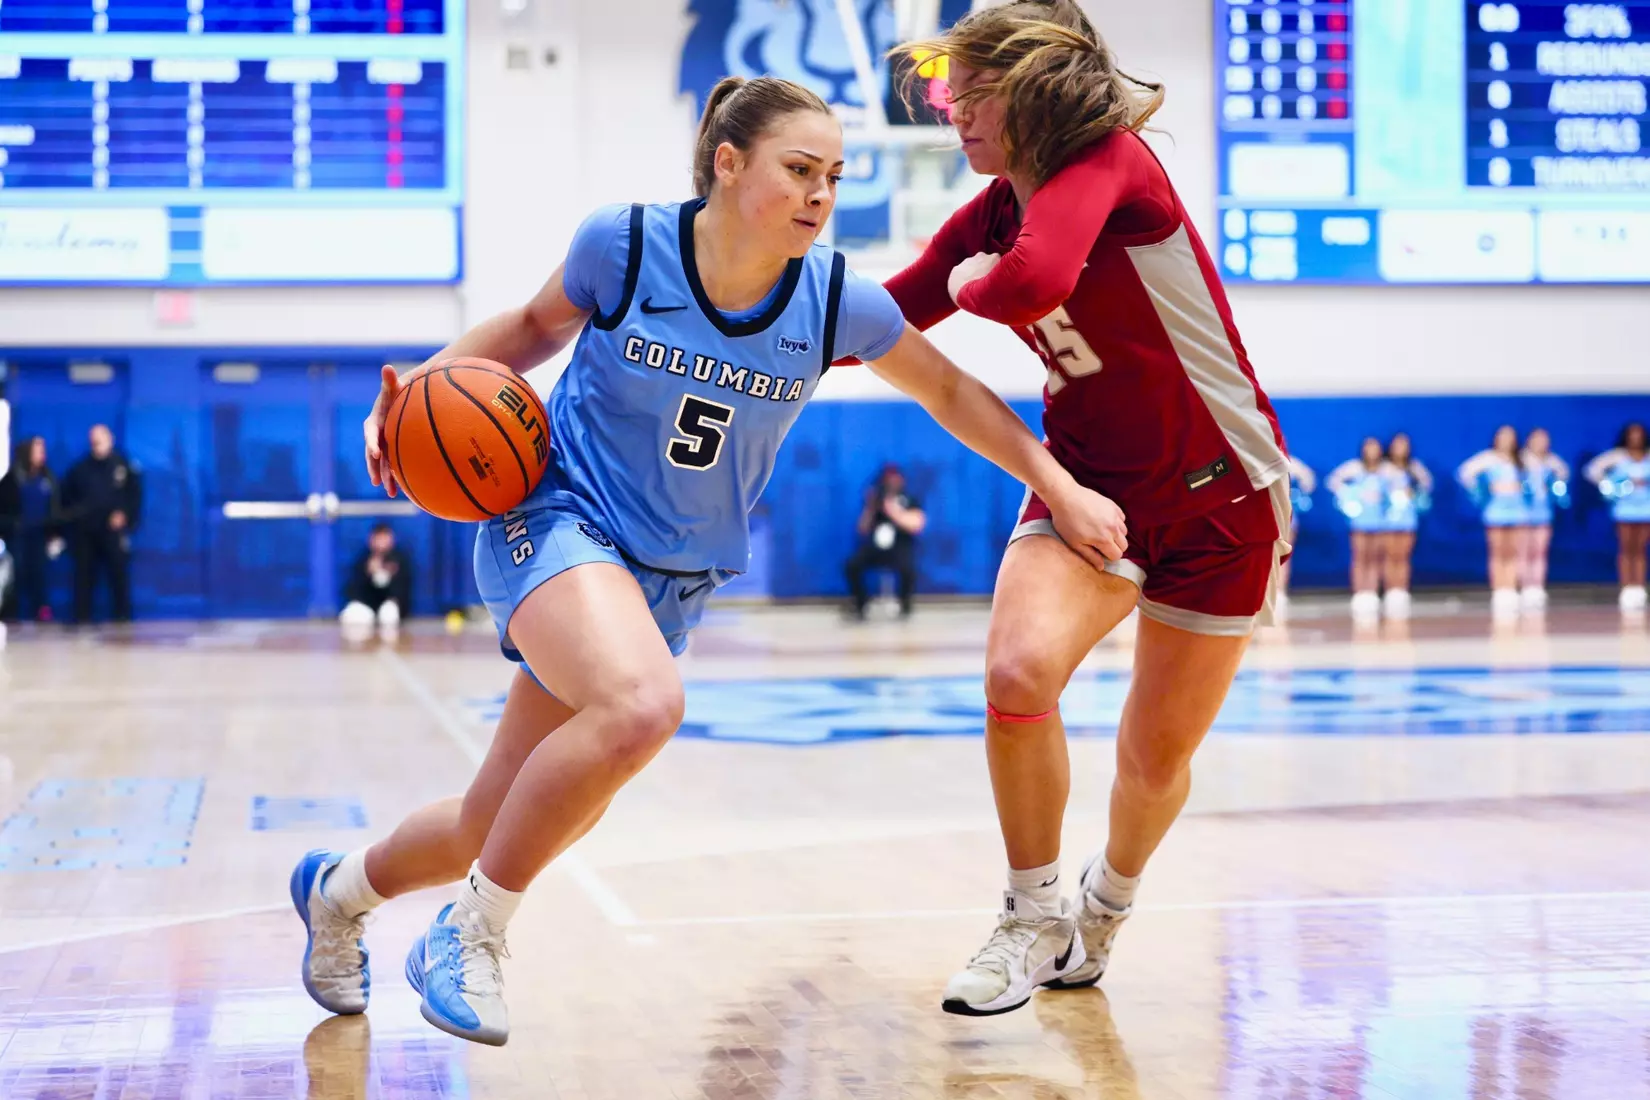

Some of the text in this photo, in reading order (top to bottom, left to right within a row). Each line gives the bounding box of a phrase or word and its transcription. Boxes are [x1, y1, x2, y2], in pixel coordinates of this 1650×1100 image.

[624, 335, 804, 401] COLUMBIA
[779, 337, 799, 352] Ivy
[496, 384, 548, 466] ELITE
[665, 393, 735, 471] 5
